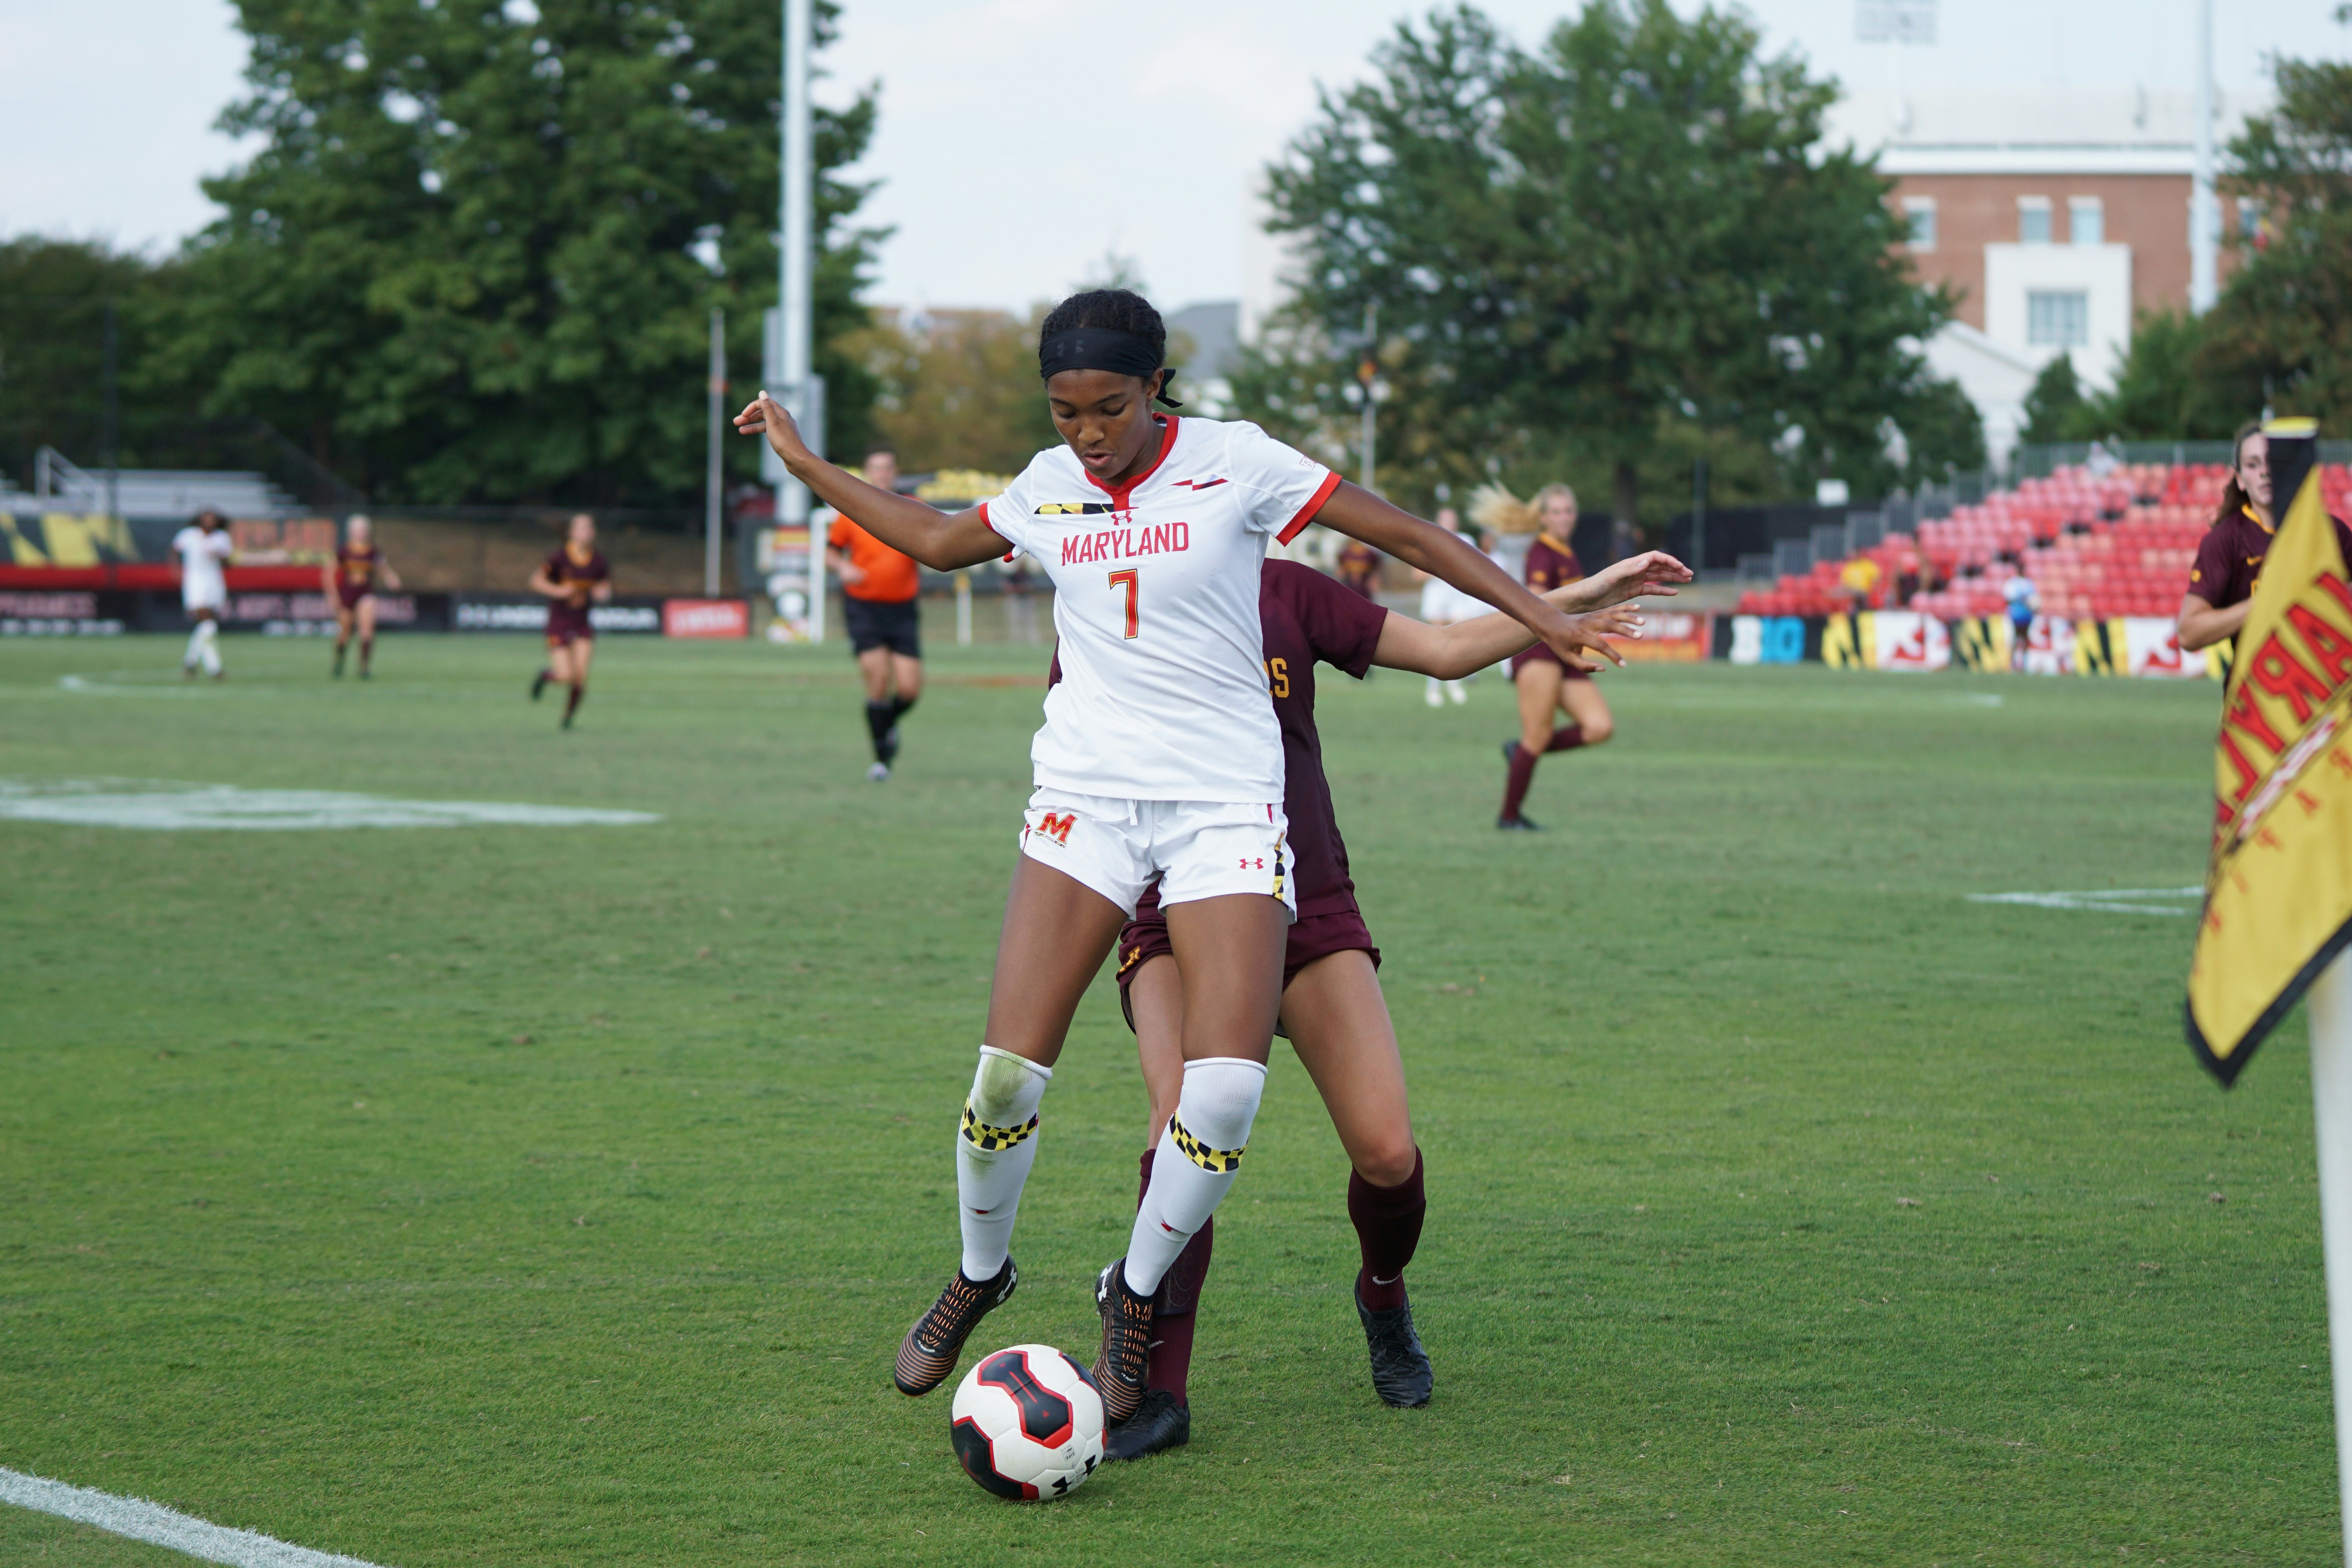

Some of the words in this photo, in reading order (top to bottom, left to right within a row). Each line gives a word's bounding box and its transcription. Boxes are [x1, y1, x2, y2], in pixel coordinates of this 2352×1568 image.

[1062, 522, 1189, 566] MARYLAND
[1108, 568, 1139, 640] 7
[1036, 813, 1078, 844] M
